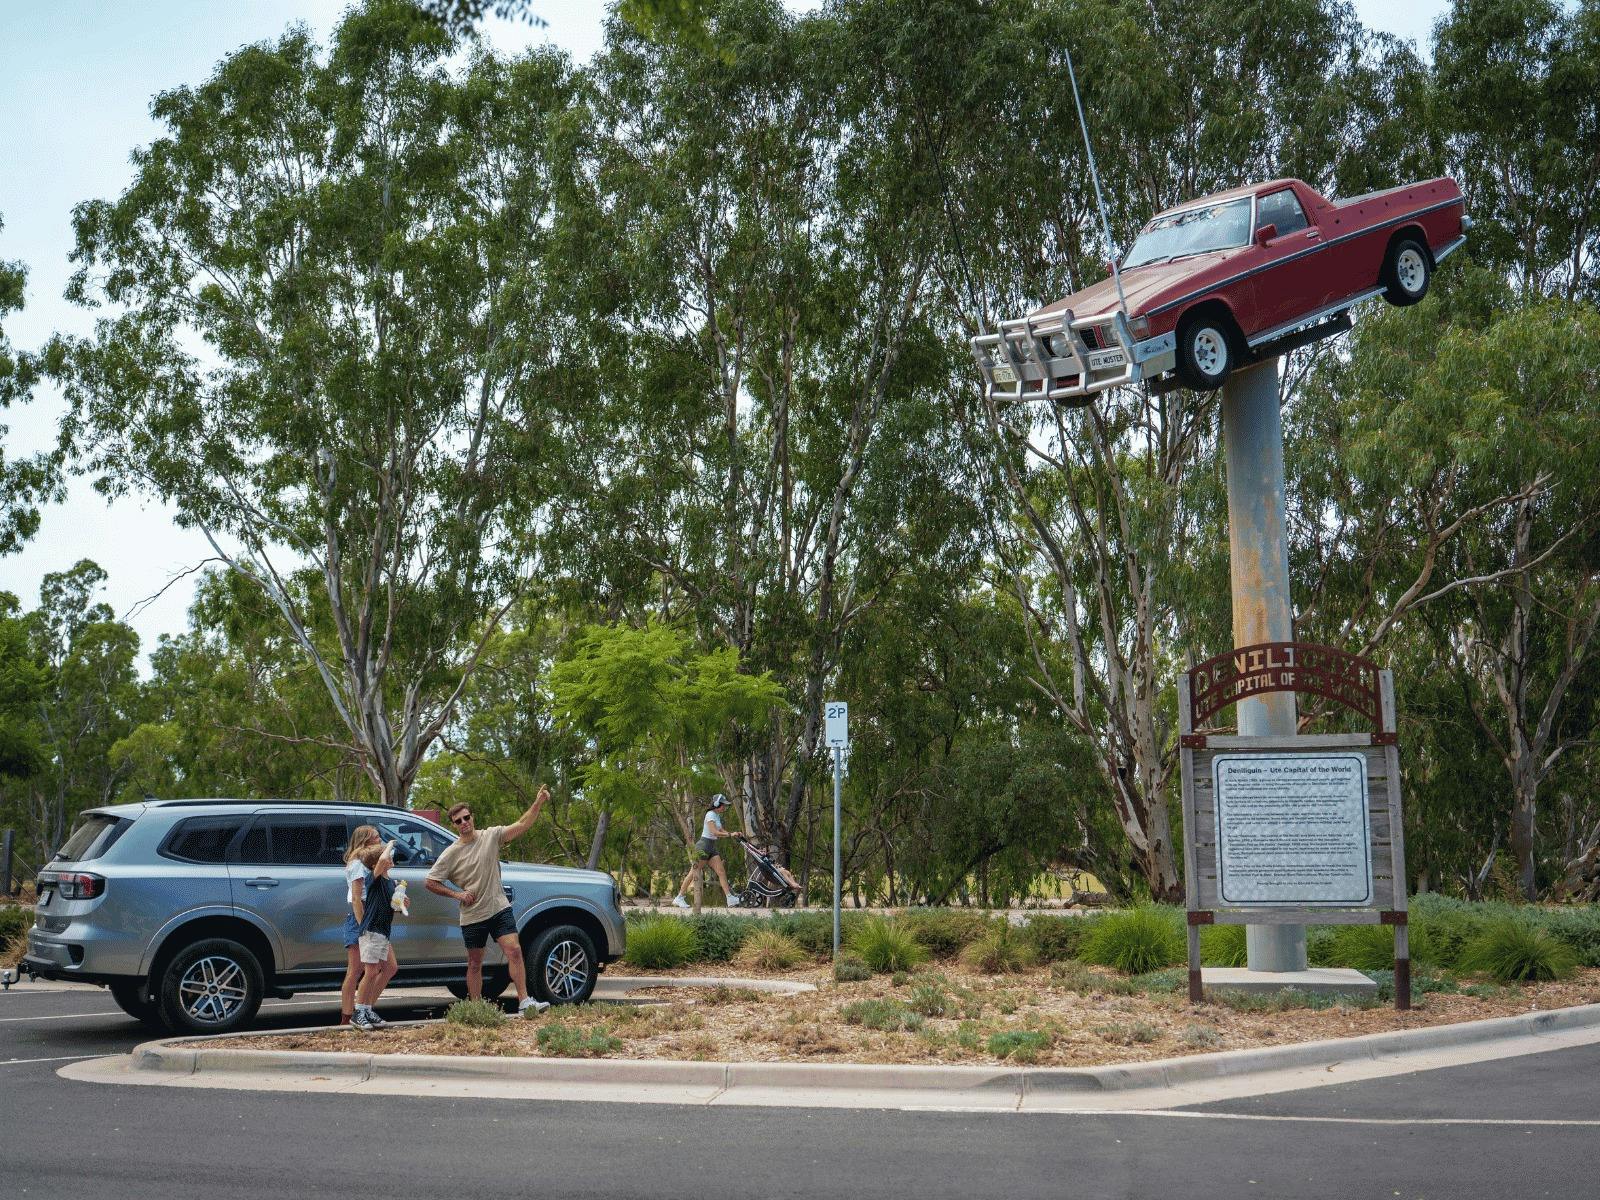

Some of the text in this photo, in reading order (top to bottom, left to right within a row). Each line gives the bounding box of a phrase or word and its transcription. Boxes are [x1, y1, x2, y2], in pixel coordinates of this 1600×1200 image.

[1091, 354, 1124, 367] UTE MUSTER
[1280, 672, 1296, 686] OF
[828, 707, 846, 718] 2P
[1227, 767, 1262, 775] Deniliquin
[1283, 766, 1308, 775] Capital
[1331, 765, 1352, 773] World
